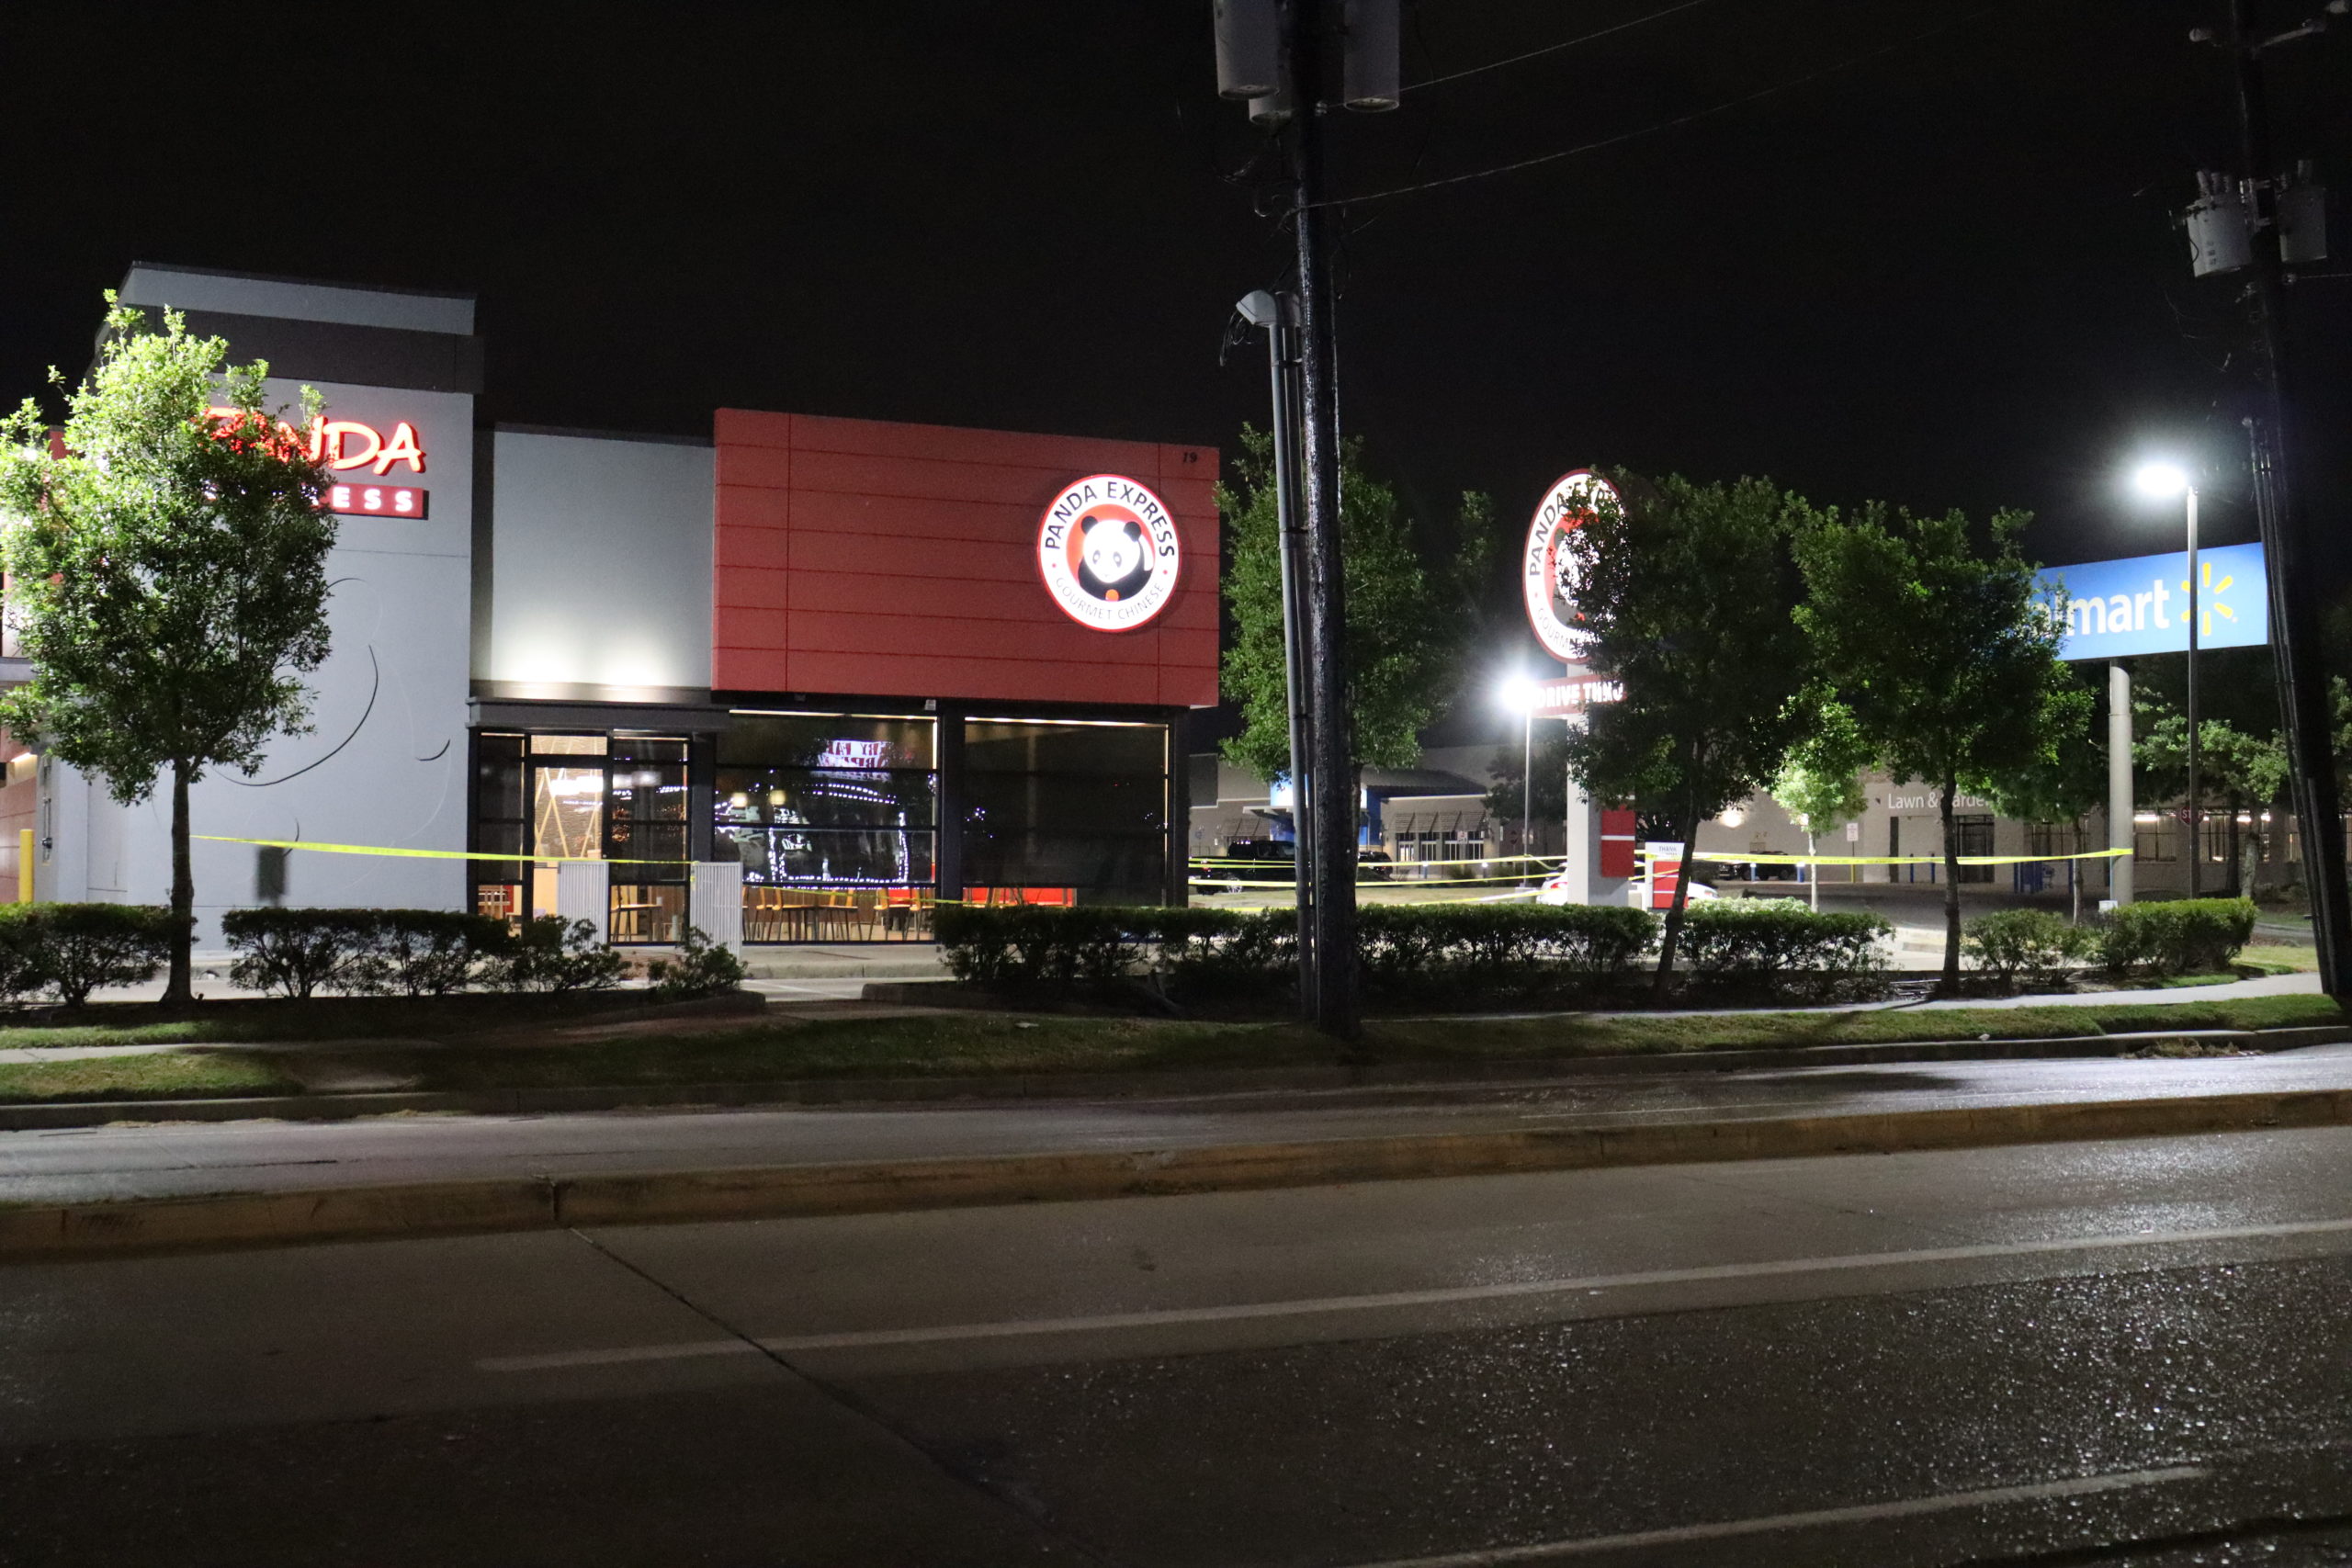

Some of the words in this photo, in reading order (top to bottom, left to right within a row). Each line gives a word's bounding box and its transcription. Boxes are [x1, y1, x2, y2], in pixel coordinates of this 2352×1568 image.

[1046, 484, 1098, 549] PANDA
[1107, 481, 1175, 557] EXPRESS
[1530, 492, 1570, 576] PANDA
[1056, 577, 1113, 619] GOURMET
[1117, 582, 1164, 620] CHINESE
[2025, 580, 2170, 637] almart
[1888, 793, 1925, 809] Lawn
[1928, 791, 1938, 808] &
[2182, 809, 2204, 819] STP
